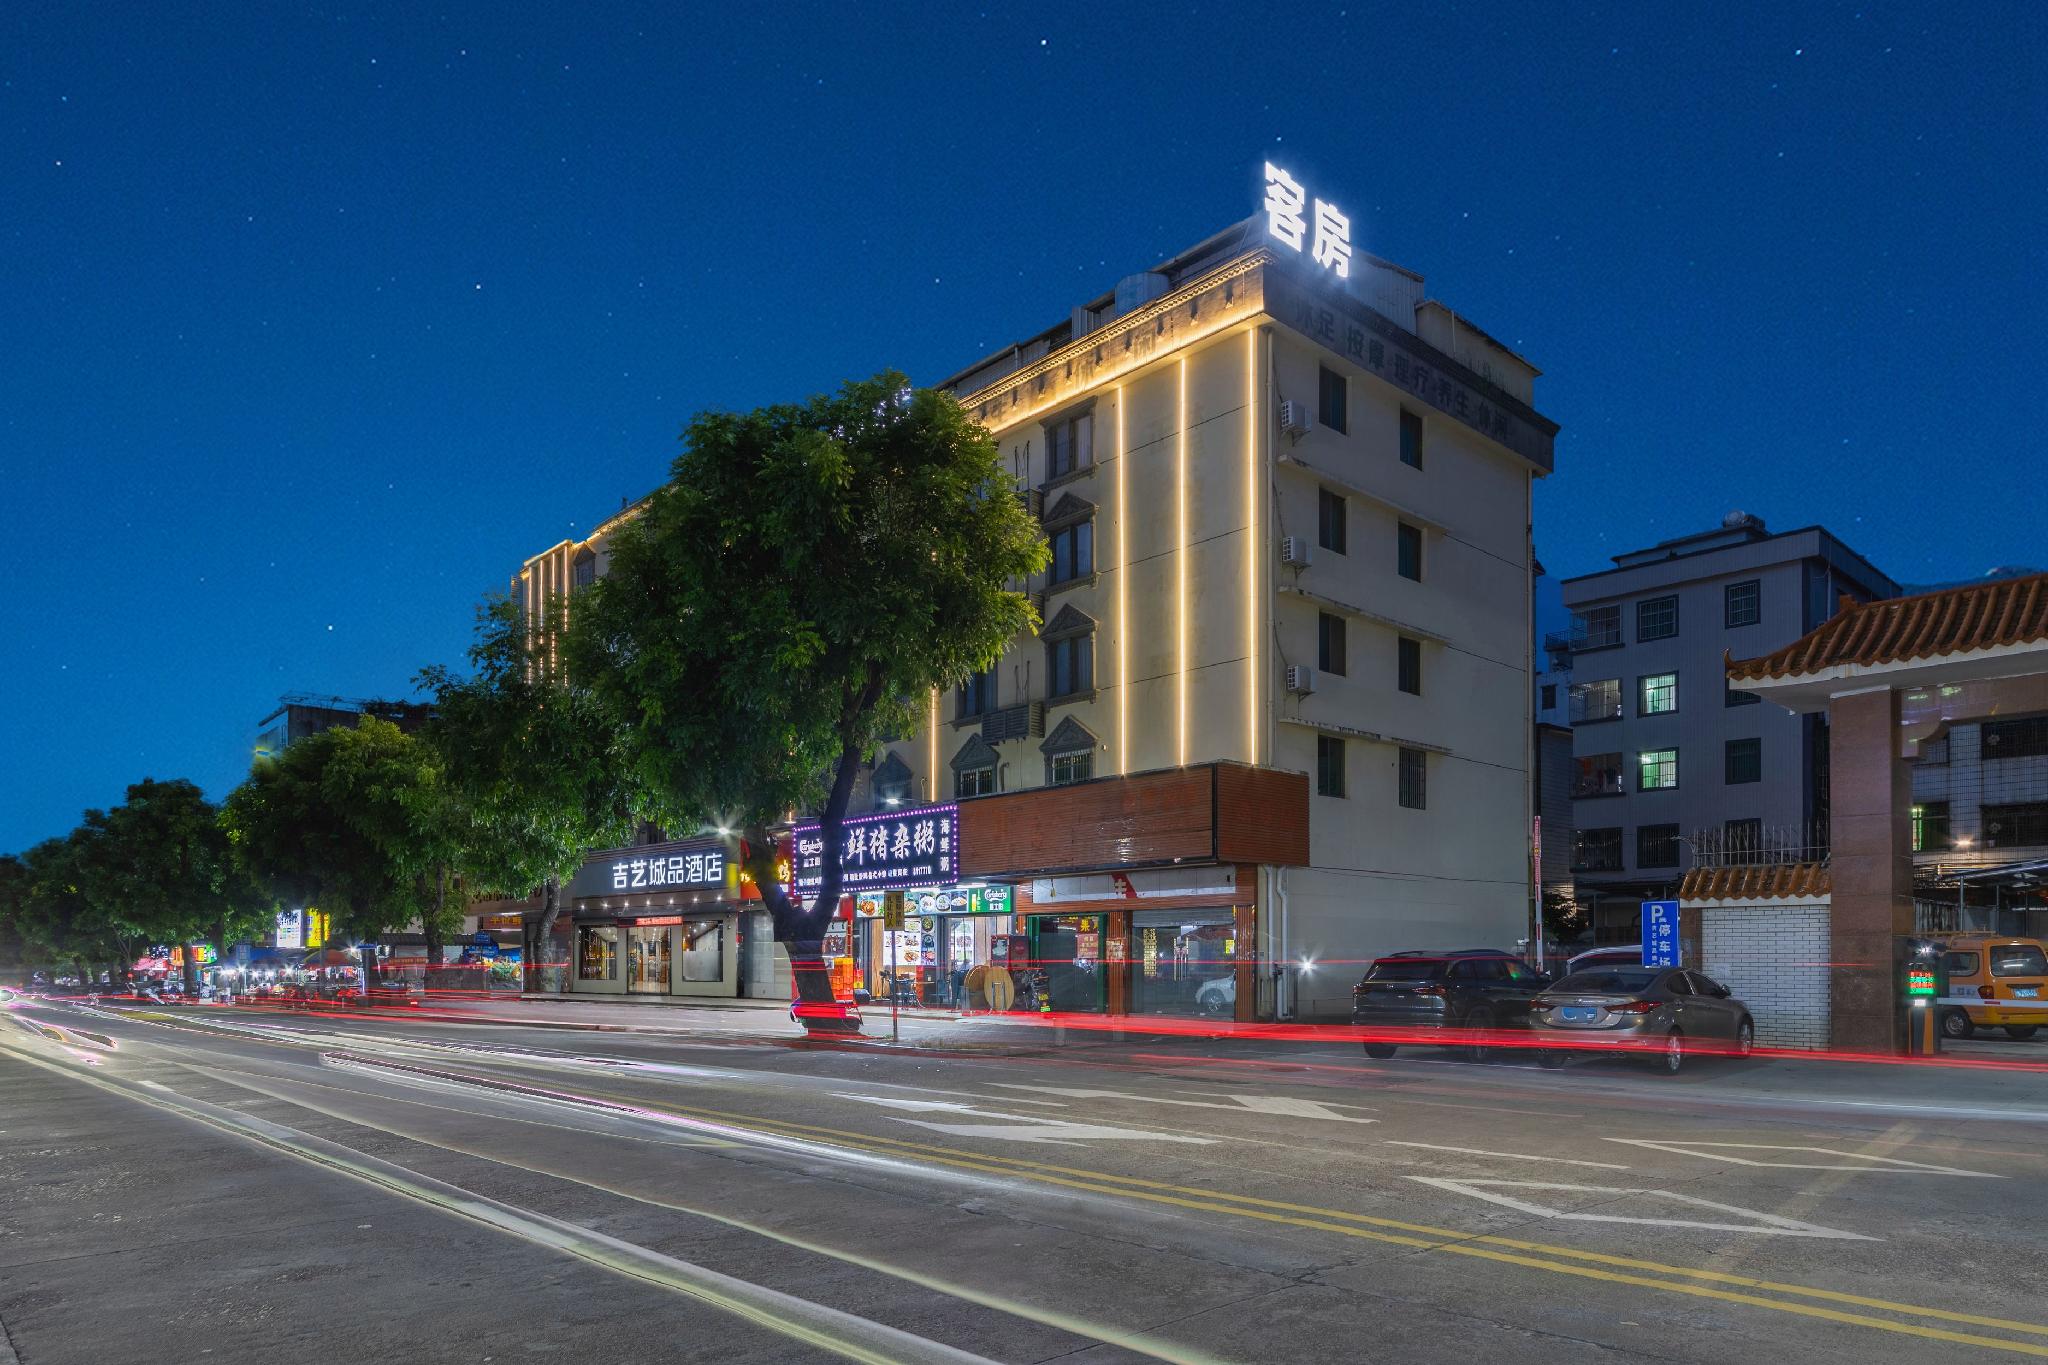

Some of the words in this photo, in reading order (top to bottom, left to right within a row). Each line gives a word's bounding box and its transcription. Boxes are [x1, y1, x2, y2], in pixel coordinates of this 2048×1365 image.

[1264, 160, 1352, 278] 客房
[1346, 325, 1385, 370] 按摩
[1394, 352, 1429, 395] 理疗
[1437, 378, 1470, 418] 养生
[839, 819, 935, 865] 鲜猪杂粥
[612, 852, 723, 889] 吉艺城品酒店
[984, 888, 1008, 902] Carlsberg
[1651, 904, 1664, 924] P
[1658, 924, 1671, 966] 停车场
